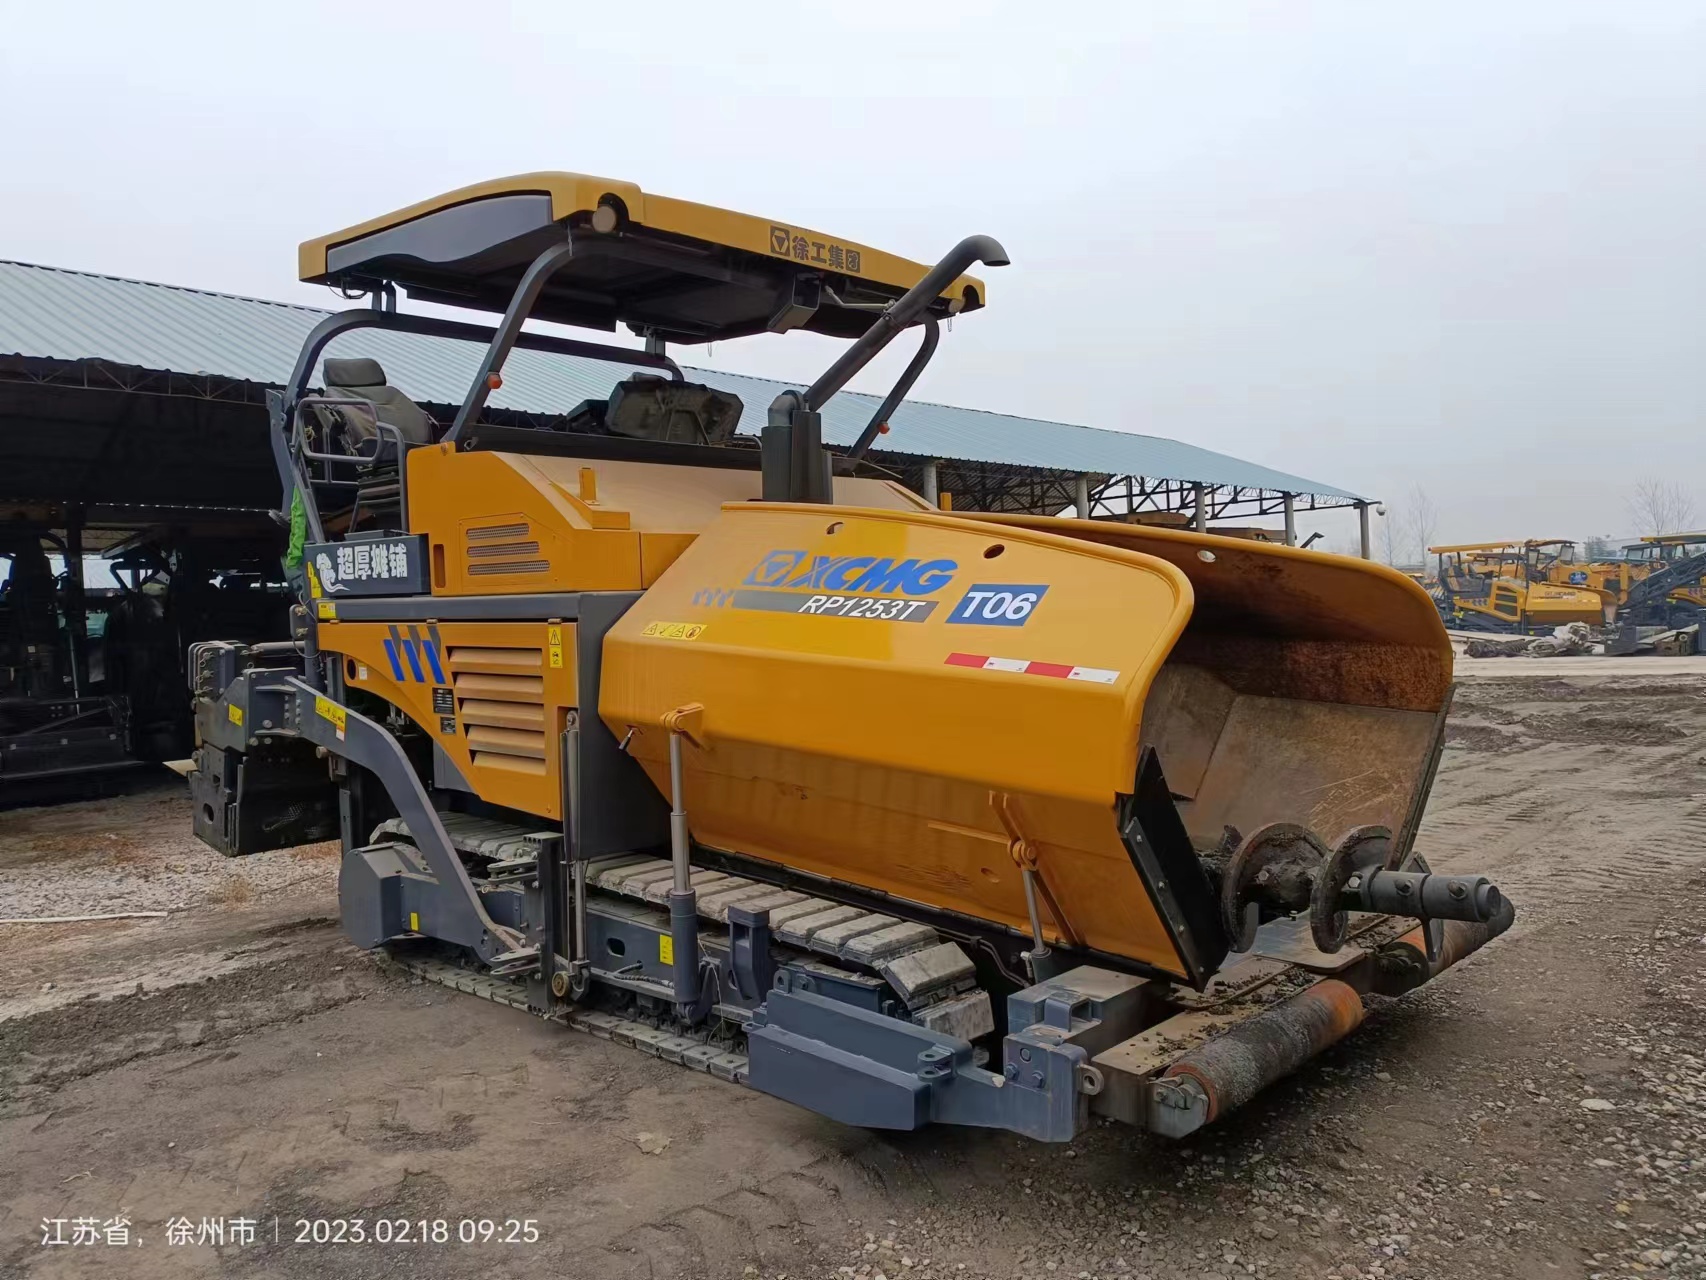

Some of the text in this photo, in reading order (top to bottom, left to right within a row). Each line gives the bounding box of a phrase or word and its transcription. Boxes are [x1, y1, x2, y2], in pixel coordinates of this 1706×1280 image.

[792, 236, 860, 273] 徐工集团
[337, 543, 408, 580] 超厚摊铺
[785, 556, 958, 595] XCMG
[798, 595, 927, 620] RP1253T
[962, 592, 1037, 620] T06
